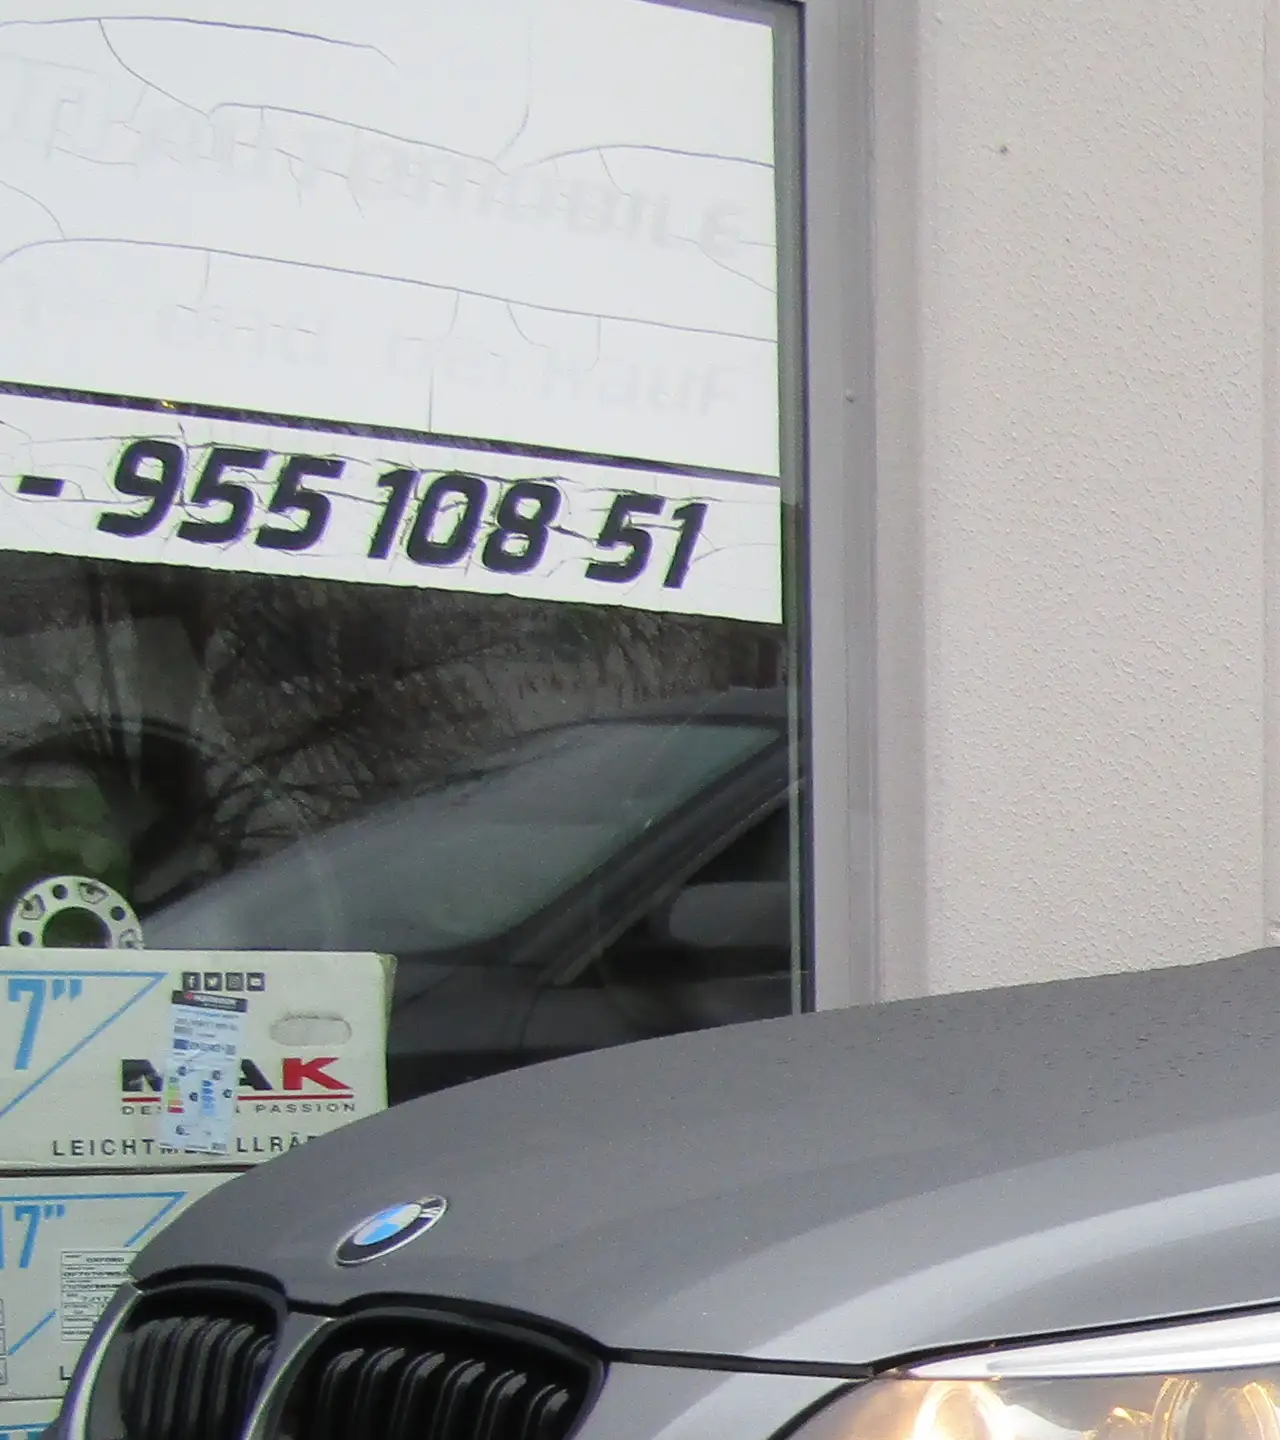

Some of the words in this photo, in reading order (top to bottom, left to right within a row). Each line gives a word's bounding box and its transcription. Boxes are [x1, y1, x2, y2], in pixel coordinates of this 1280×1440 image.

[95, 437, 345, 553] 955
[366, 464, 562, 578] 108
[586, 492, 709, 590] 51
[121, 1057, 353, 1092] MAK
[256, 1103, 356, 1114] PASSION
